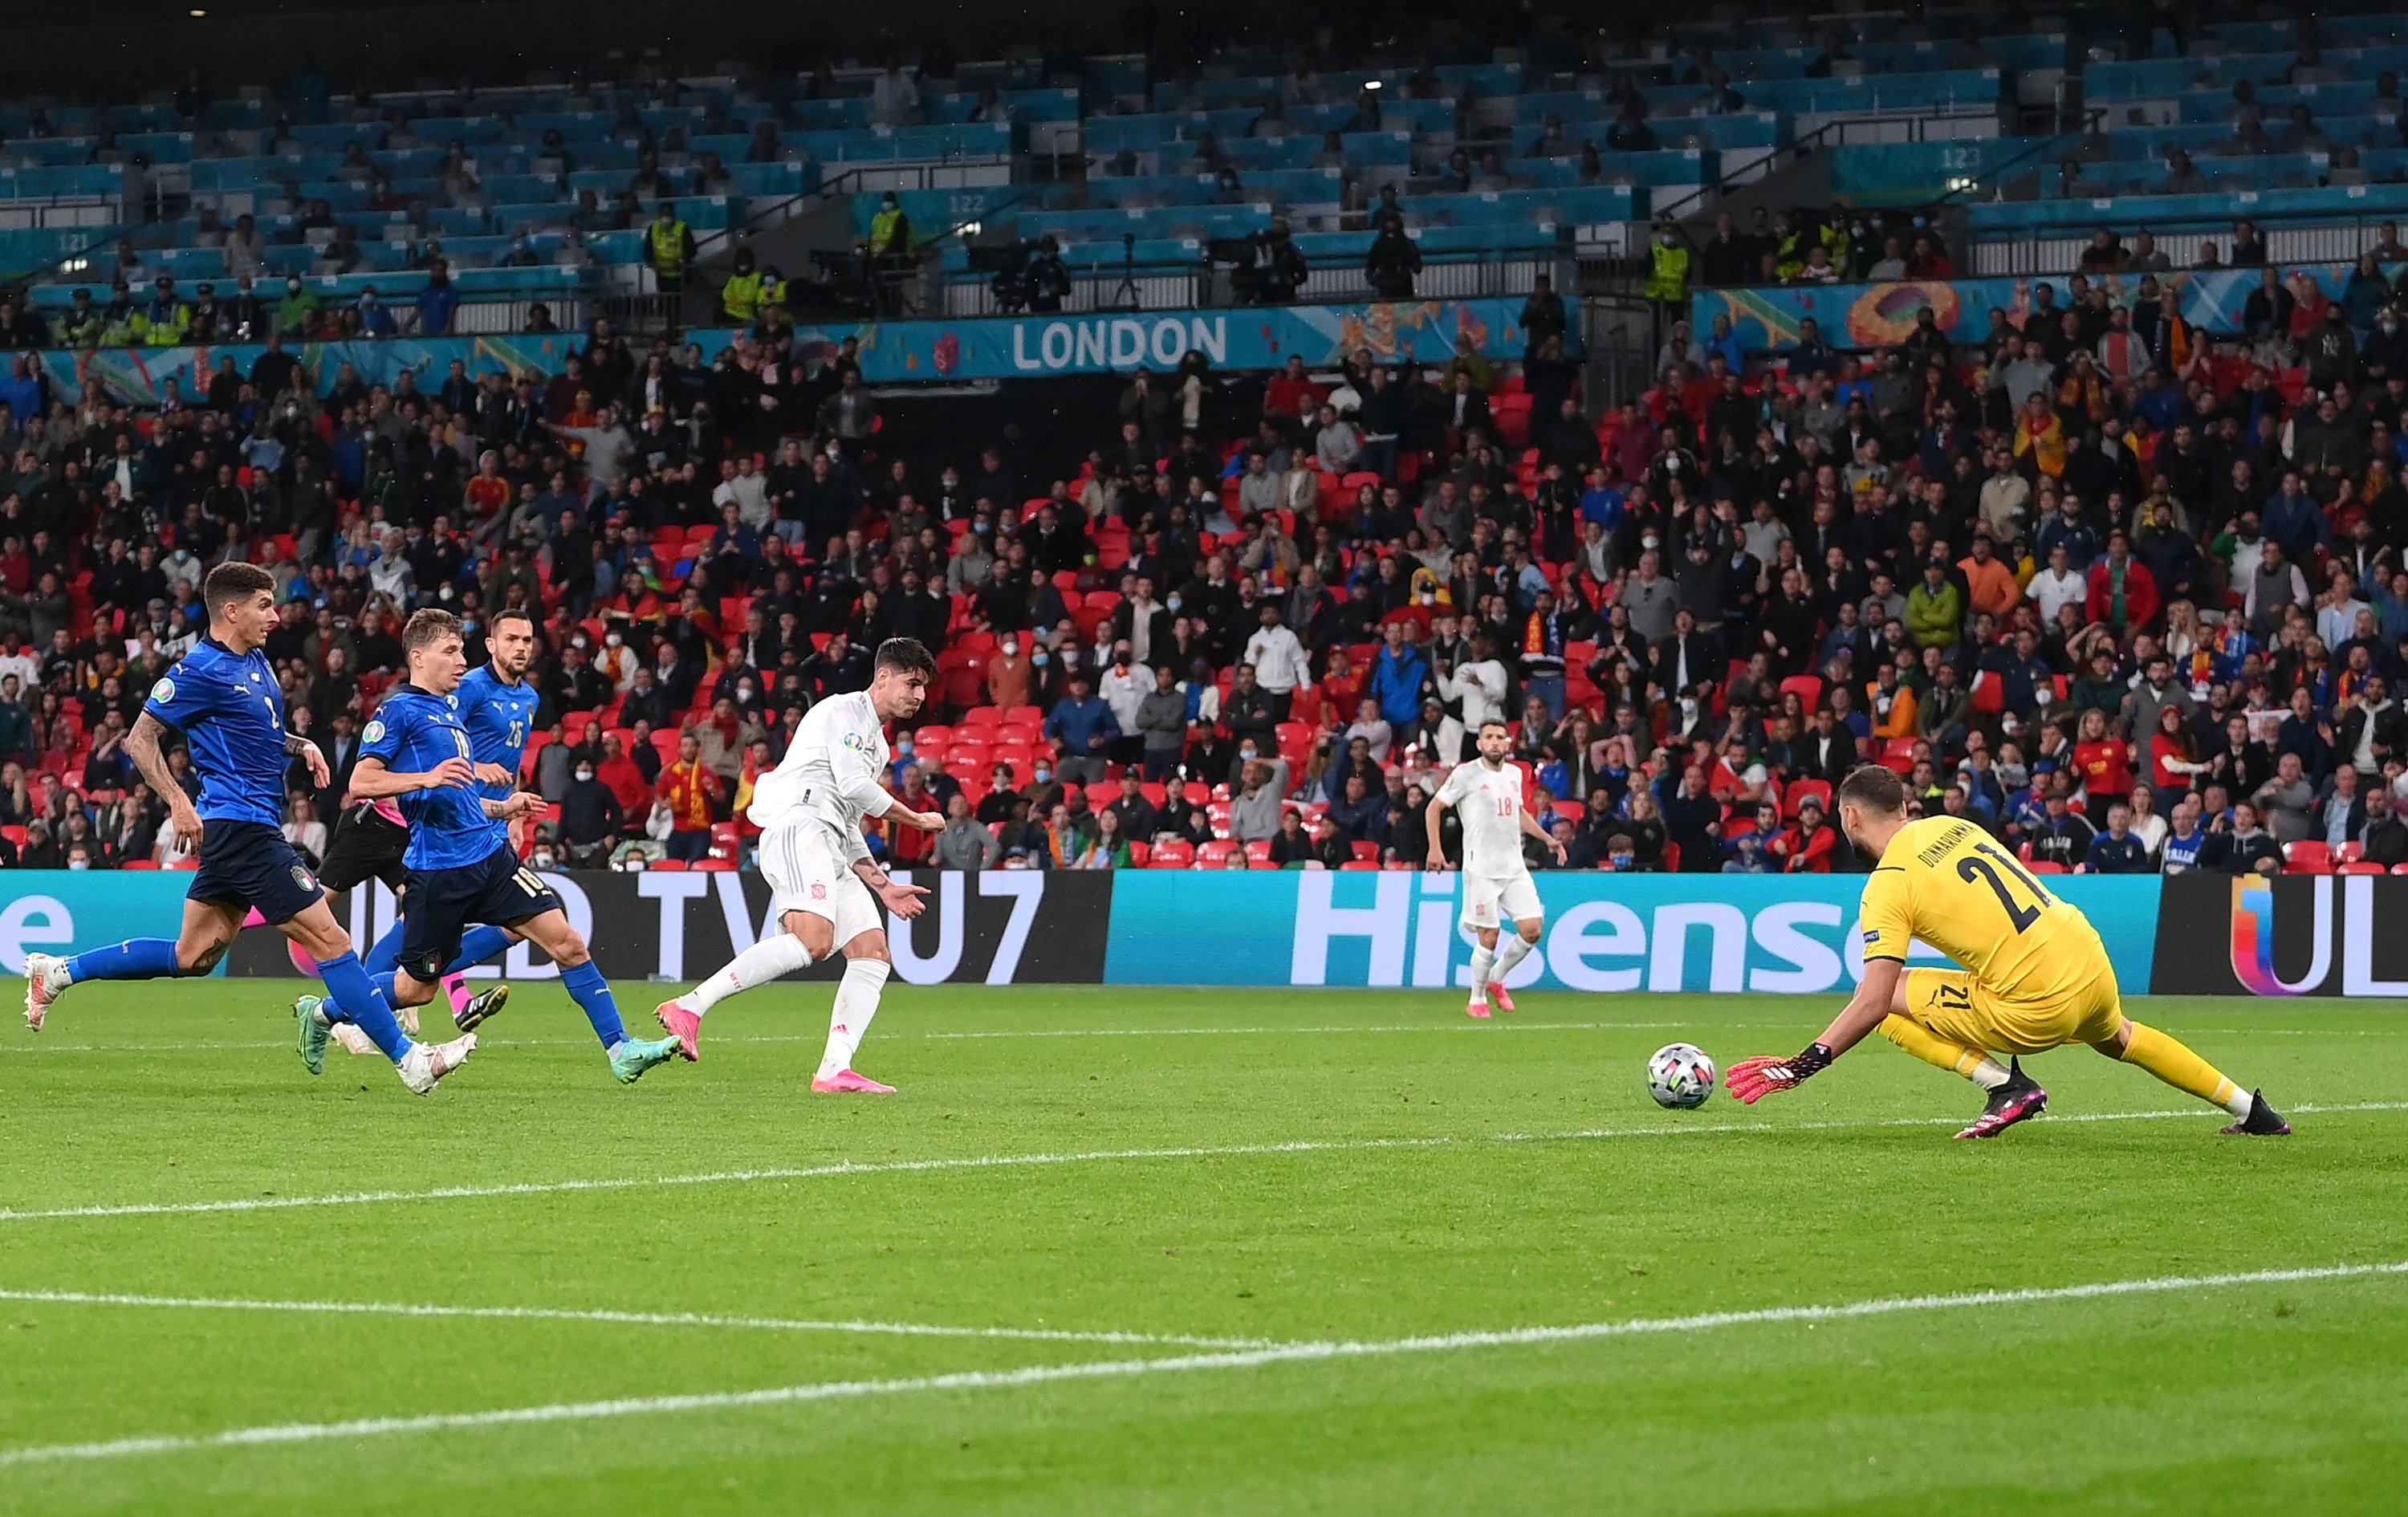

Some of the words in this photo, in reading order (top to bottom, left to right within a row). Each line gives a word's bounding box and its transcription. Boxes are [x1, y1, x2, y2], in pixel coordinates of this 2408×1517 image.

[1942, 147, 1982, 168] 123
[949, 195, 985, 213] 122
[1015, 317, 1226, 369] LONDON
[263, 696, 280, 730] 2
[1497, 796, 1512, 817] 18
[1917, 820, 1979, 868] DONNARUMMA
[511, 866, 544, 898] 18
[1956, 842, 2053, 935] 21
[887, 870, 1044, 986] U7
[1291, 869, 1947, 994] Hisens
[1941, 984, 1971, 1009] 21
